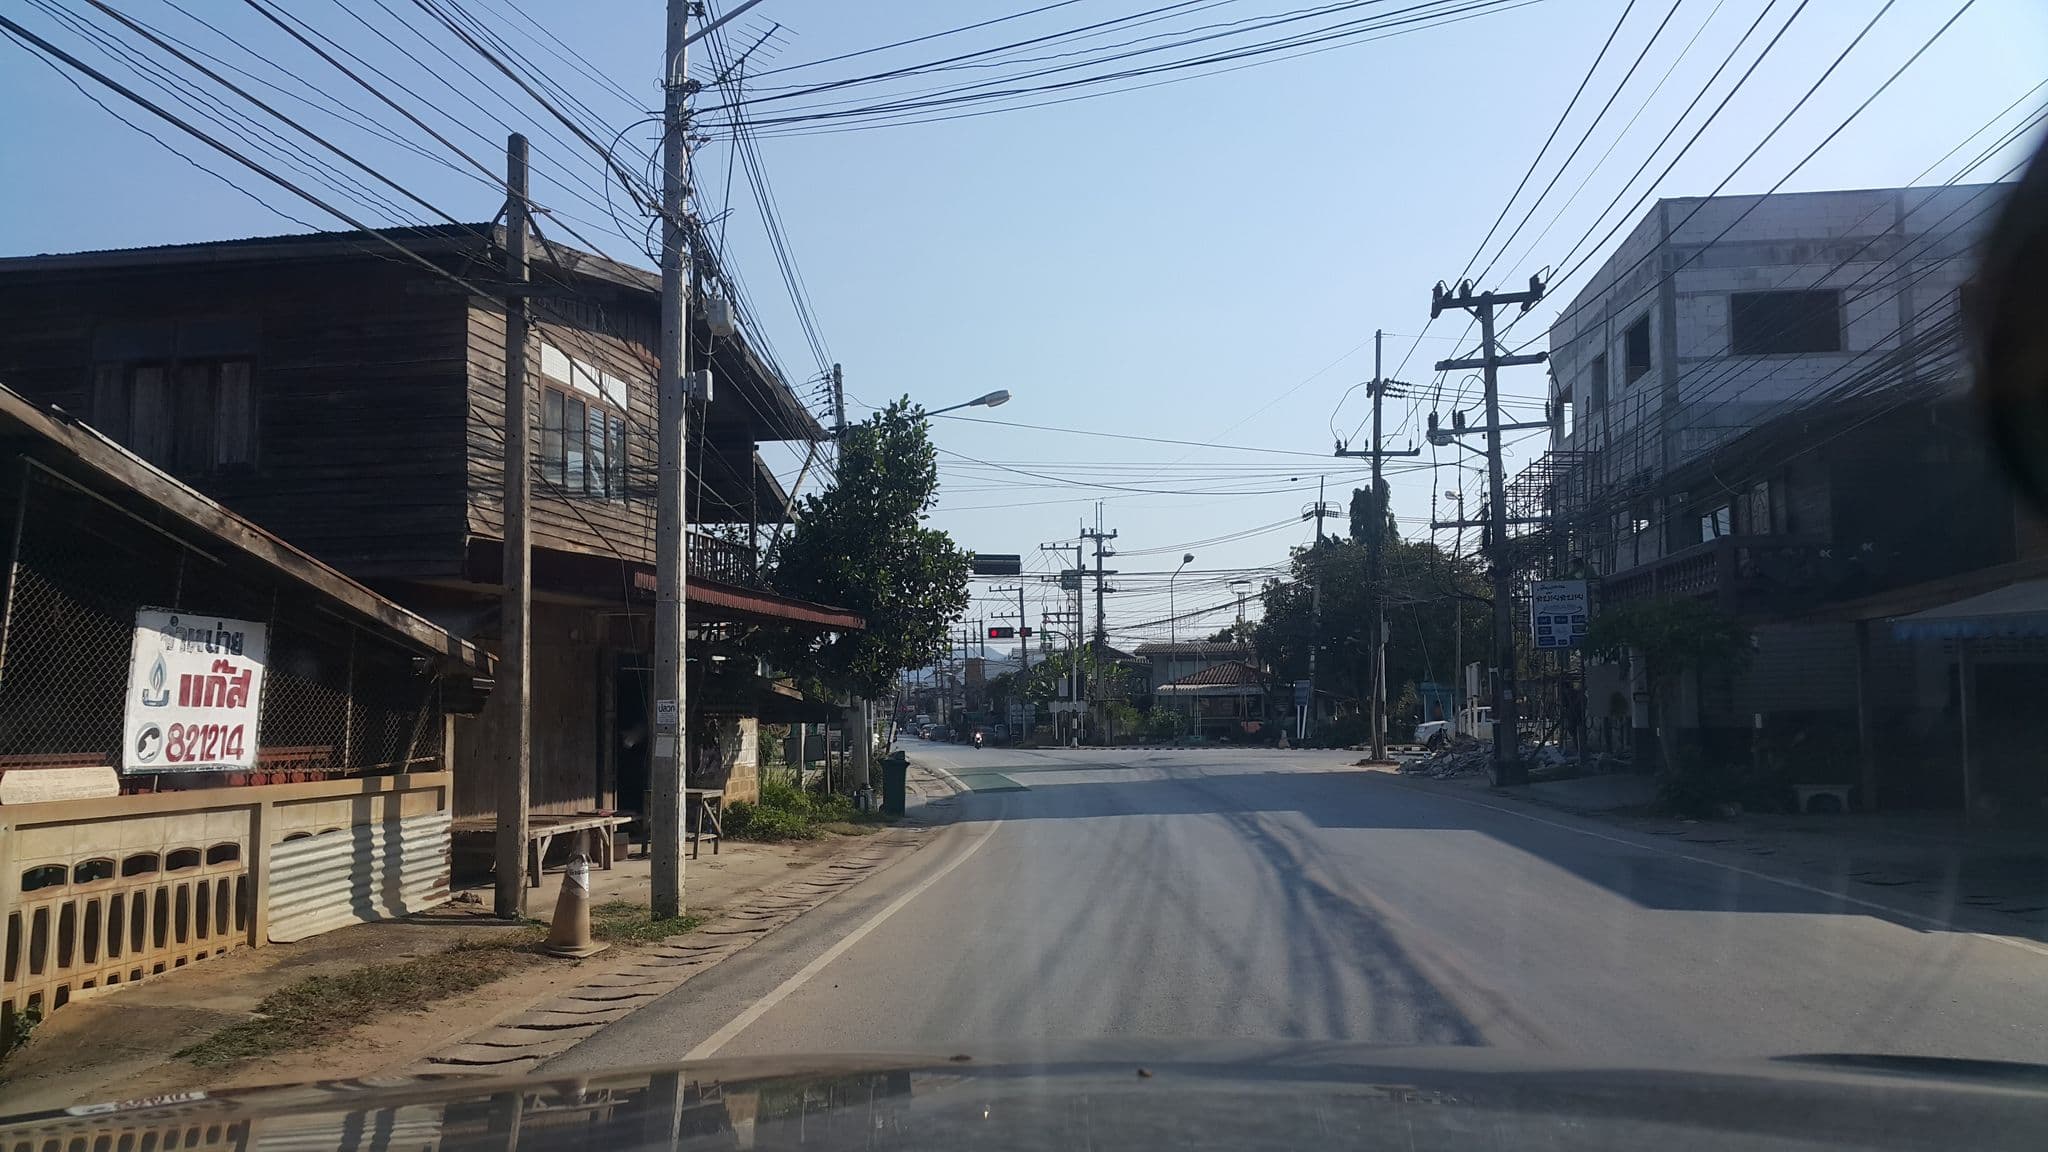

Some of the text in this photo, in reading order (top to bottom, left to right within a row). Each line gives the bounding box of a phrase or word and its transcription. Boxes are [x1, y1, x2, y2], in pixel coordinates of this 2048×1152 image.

[160, 616, 244, 656] จำหน่าย
[178, 659, 252, 709] แก๊ส
[165, 722, 245, 763] 821214
